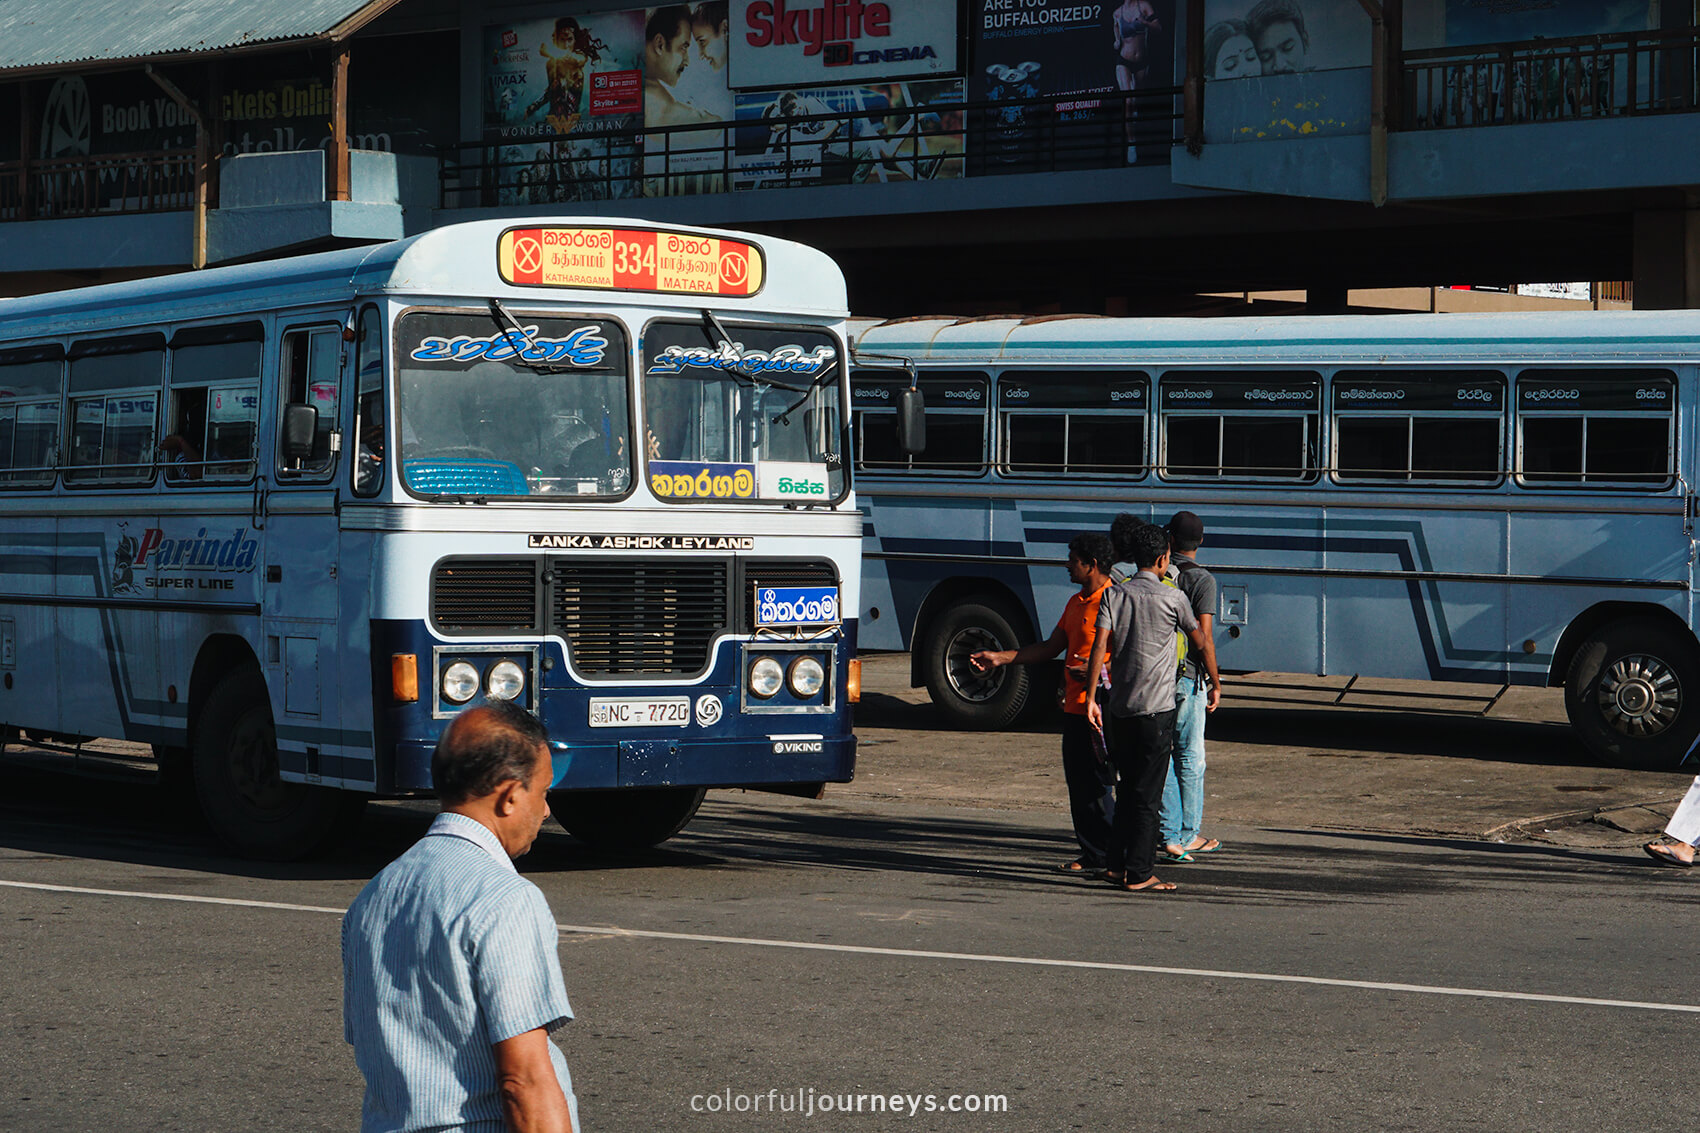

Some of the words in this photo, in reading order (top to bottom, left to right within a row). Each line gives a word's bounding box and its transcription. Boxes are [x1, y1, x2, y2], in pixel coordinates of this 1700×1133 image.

[984, 0, 1013, 11] ARE
[983, 5, 1102, 29] BUFFALORIZED?
[746, 0, 891, 56] Skylite
[983, 30, 1013, 40] BUFFALO
[1014, 27, 1042, 37] ENERGY
[1043, 25, 1065, 35] DRINK
[824, 44, 850, 64] 3D
[853, 45, 937, 65] CINEMA
[102, 101, 151, 134] Book
[222, 88, 277, 121] ckets
[1056, 102, 1074, 112] SWISS
[1075, 99, 1101, 110] QUALITY
[501, 124, 552, 137] WONDER
[575, 119, 623, 132] WOMAN
[544, 230, 612, 249] කතරගම
[668, 236, 711, 256] මාතර
[615, 241, 656, 276] 334
[545, 273, 611, 285] KATHARAGAMA
[663, 277, 714, 292] MATARA
[650, 469, 754, 497] කතරගම
[132, 527, 260, 573] Parinda
[529, 535, 593, 547] LANKA
[600, 536, 665, 549] ASHOK
[671, 537, 753, 549] LEYLAND
[145, 577, 194, 589] SUPER
[199, 578, 234, 590] LINE
[609, 705, 629, 721] NC
[785, 743, 822, 752] VIKING
